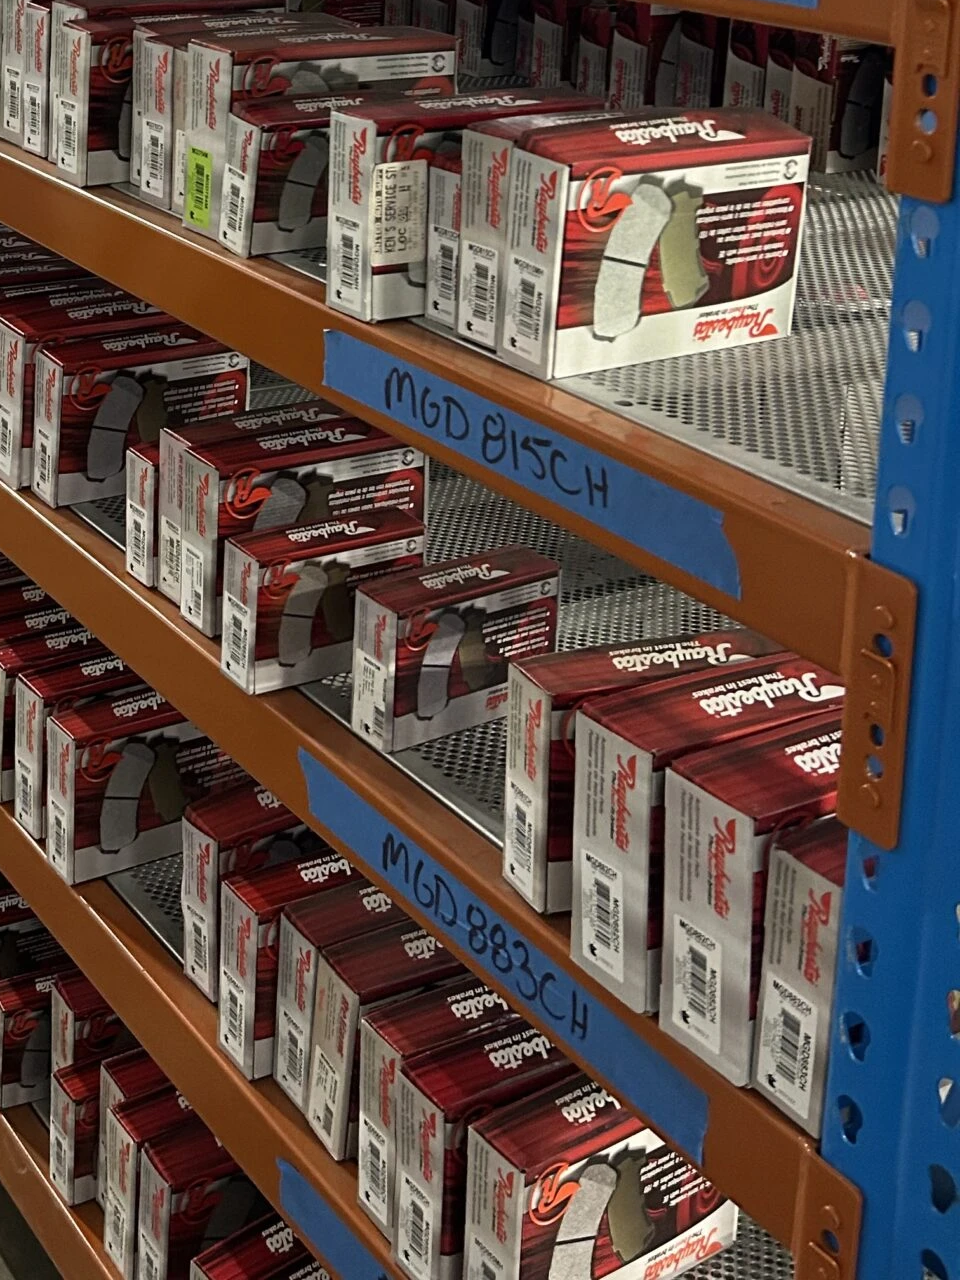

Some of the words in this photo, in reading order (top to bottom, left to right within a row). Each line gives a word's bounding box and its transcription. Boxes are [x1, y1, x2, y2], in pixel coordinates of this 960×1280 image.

[156, 50, 169, 115] Raybestos
[208, 58, 221, 131] Raybestos
[614, 119, 746, 146] Raybestos
[353, 127, 368, 206] Raybestos
[385, 183, 397, 222] SERVICE
[487, 147, 508, 229] Raybestos
[540, 170, 558, 254] Raybestos
[384, 225, 397, 253] KEN'S
[397, 227, 407, 252] LOC
[68, 300, 167, 321] Raybestos
[693, 308, 779, 342] Raybestos
[103, 331, 198, 351] Raybestos
[5, 340, 18, 399] Raybestos
[234, 408, 340, 430] Raybestos
[259, 428, 368, 451] Raybestos
[384, 367, 470, 441] MGD
[481, 412, 609, 508] 815CH
[198, 473, 208, 538] Raybestos
[288, 520, 376, 542] Raybestos
[422, 563, 511, 589] Raybestos
[609, 647, 641, 657] brakes
[613, 641, 757, 672] Raybestos
[657, 642, 675, 651] best
[681, 640, 700, 648] The
[691, 685, 723, 699] brakes
[724, 682, 735, 690] in
[737, 676, 758, 687] best
[763, 671, 784, 681] The
[699, 672, 846, 718] Raybestos
[527, 700, 543, 781] Raybestos
[785, 739, 818, 756] brakes
[820, 734, 832, 744] in
[615, 754, 637, 852] Raybestos
[197, 843, 209, 904] Raybestos
[712, 818, 737, 917] Raybestos
[381, 832, 458, 928] MGD
[466, 903, 588, 1042] 883CH
[808, 891, 833, 986] Raybestos
[298, 946, 312, 1012] Raybestos
[447, 990, 469, 1002] brakes
[451, 992, 509, 1020] bestos
[484, 1037, 511, 1053] brakes
[380, 1057, 396, 1129] Raybestos
[555, 1091, 581, 1106] brakes
[561, 1089, 622, 1125] bestos
[421, 1108, 435, 1183] Raybestos
[496, 1169, 514, 1245] Raybestos
[644, 1227, 724, 1280] Raybestos
